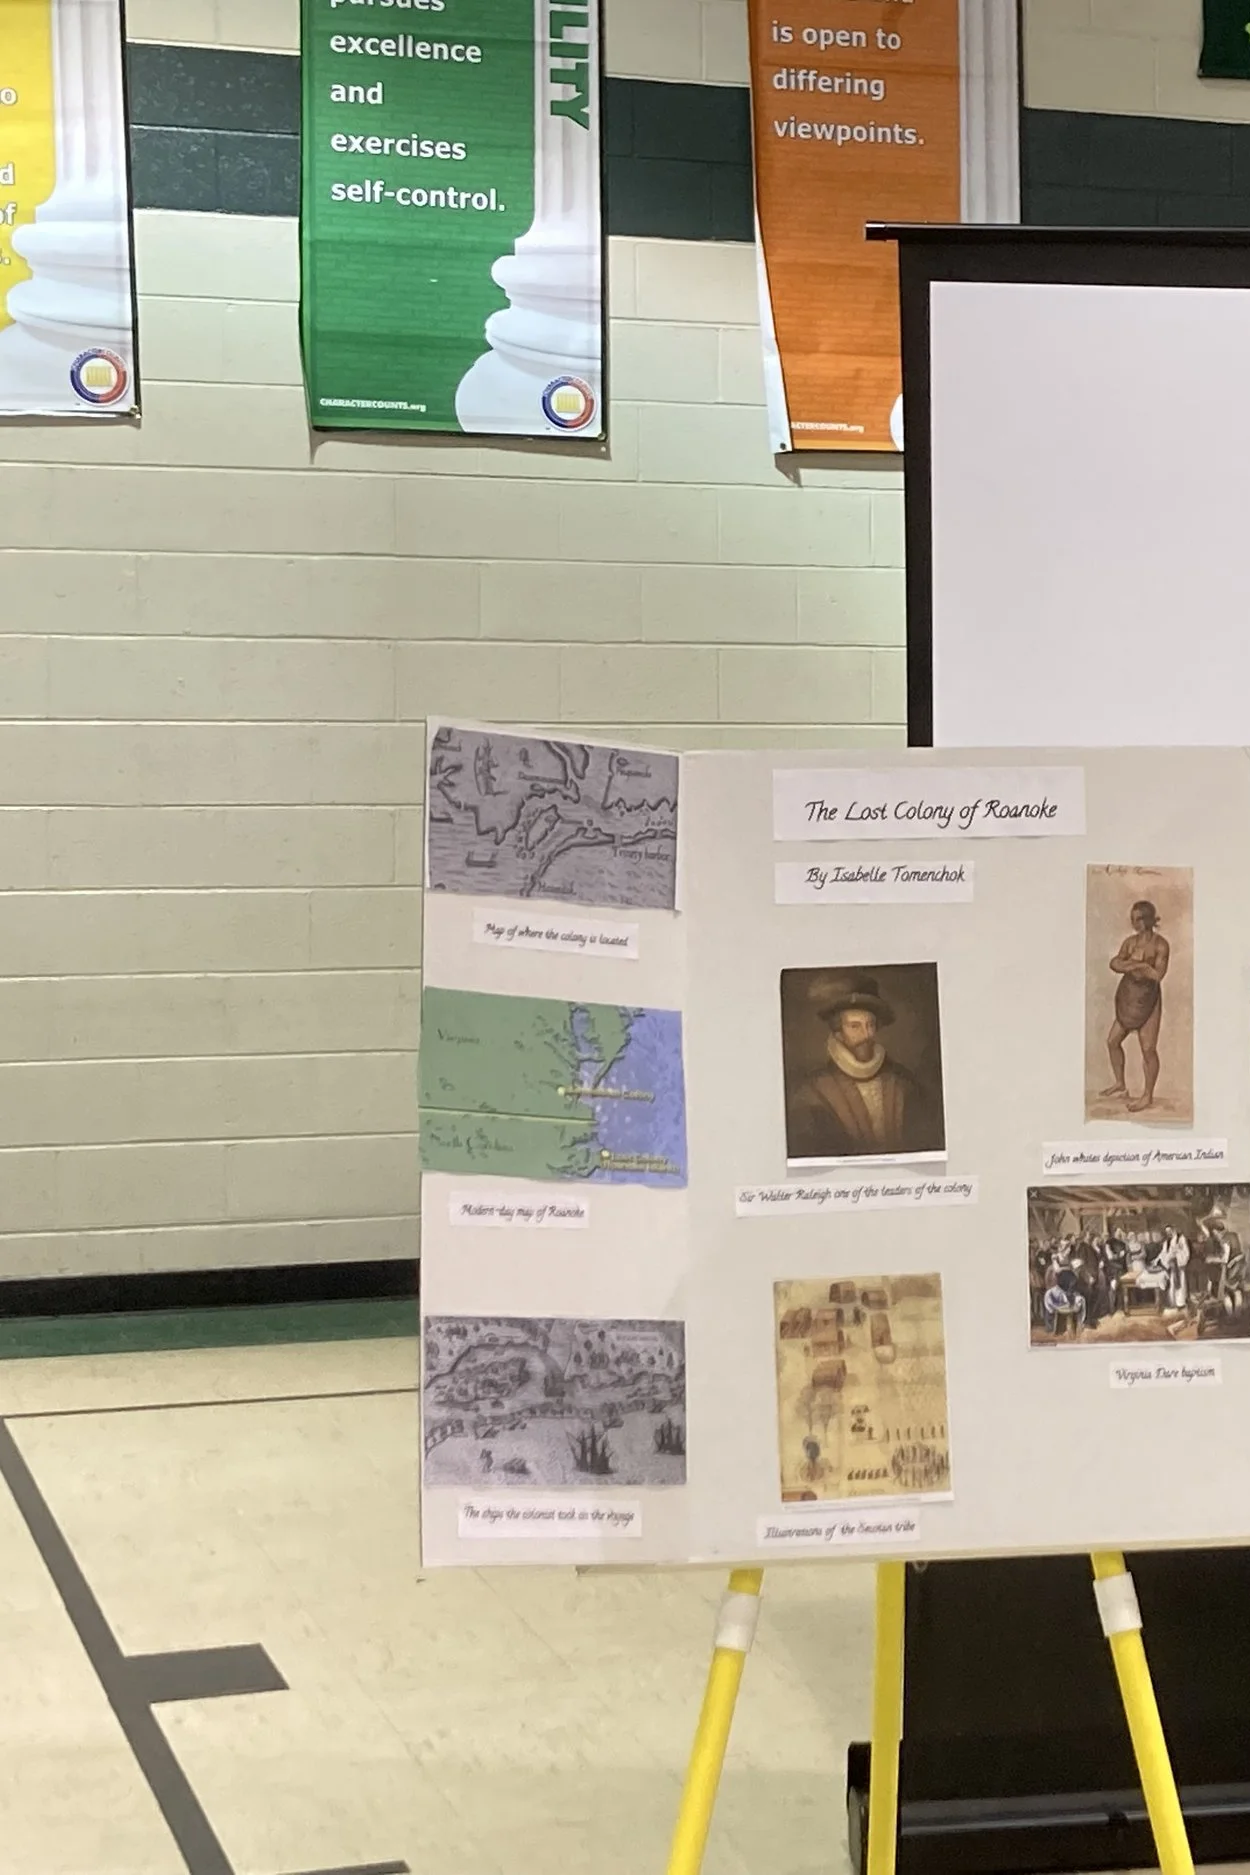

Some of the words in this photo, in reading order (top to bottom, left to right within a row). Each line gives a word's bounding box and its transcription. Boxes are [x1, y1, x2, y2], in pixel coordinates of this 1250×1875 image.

[772, 20, 794, 43] is
[802, 27, 867, 50] open
[876, 28, 901, 50] to
[330, 34, 482, 63] excellence
[330, 82, 384, 105] and
[773, 68, 885, 100] differing
[774, 116, 925, 146] viewpoints.
[330, 134, 467, 160] exercises
[331, 179, 506, 212] self-control.
[319, 397, 427, 413] CHARACTERCOUNTS.org
[804, 799, 838, 822] The
[845, 801, 888, 821] Lost
[894, 800, 955, 829] Colony
[959, 798, 984, 830] of
[982, 796, 1058, 819] Roanoke
[805, 867, 829, 890] By
[829, 865, 887, 883] Isabelle
[892, 864, 966, 883] Tomenchok
[484, 923, 505, 939] Map
[507, 925, 518, 941] of
[518, 926, 543, 939] where
[545, 928, 559, 940] the
[560, 931, 587, 947] colony
[589, 933, 596, 943] is
[599, 933, 629, 946] located
[1045, 1152, 1071, 1169] John
[1102, 1151, 1140, 1167] depiction
[1142, 1150, 1153, 1167] of
[1152, 1149, 1192, 1162] American
[1194, 1148, 1224, 1160] Indian
[739, 1190, 755, 1203] Sir
[759, 1190, 792, 1202] Walter
[795, 1188, 831, 1205] Raleigh
[834, 1189, 850, 1199] one
[851, 1186, 864, 1204] of
[864, 1186, 879, 1197] the
[881, 1184, 913, 1196] leaders
[914, 1182, 927, 1200] of
[927, 1182, 941, 1194] the
[943, 1181, 973, 1197] colony
[460, 1204, 515, 1222] Modern-day
[535, 1205, 548, 1223] of
[548, 1205, 585, 1218] Roanoke
[1115, 1367, 1152, 1385] Virginia
[1155, 1366, 1179, 1379] Dare
[1181, 1364, 1215, 1383] baptism
[464, 1504, 480, 1518] The
[506, 1509, 520, 1519] the
[591, 1510, 605, 1520] the
[825, 1523, 837, 1542] of
[840, 1520, 855, 1535] the
[894, 1519, 916, 1532] tribe
